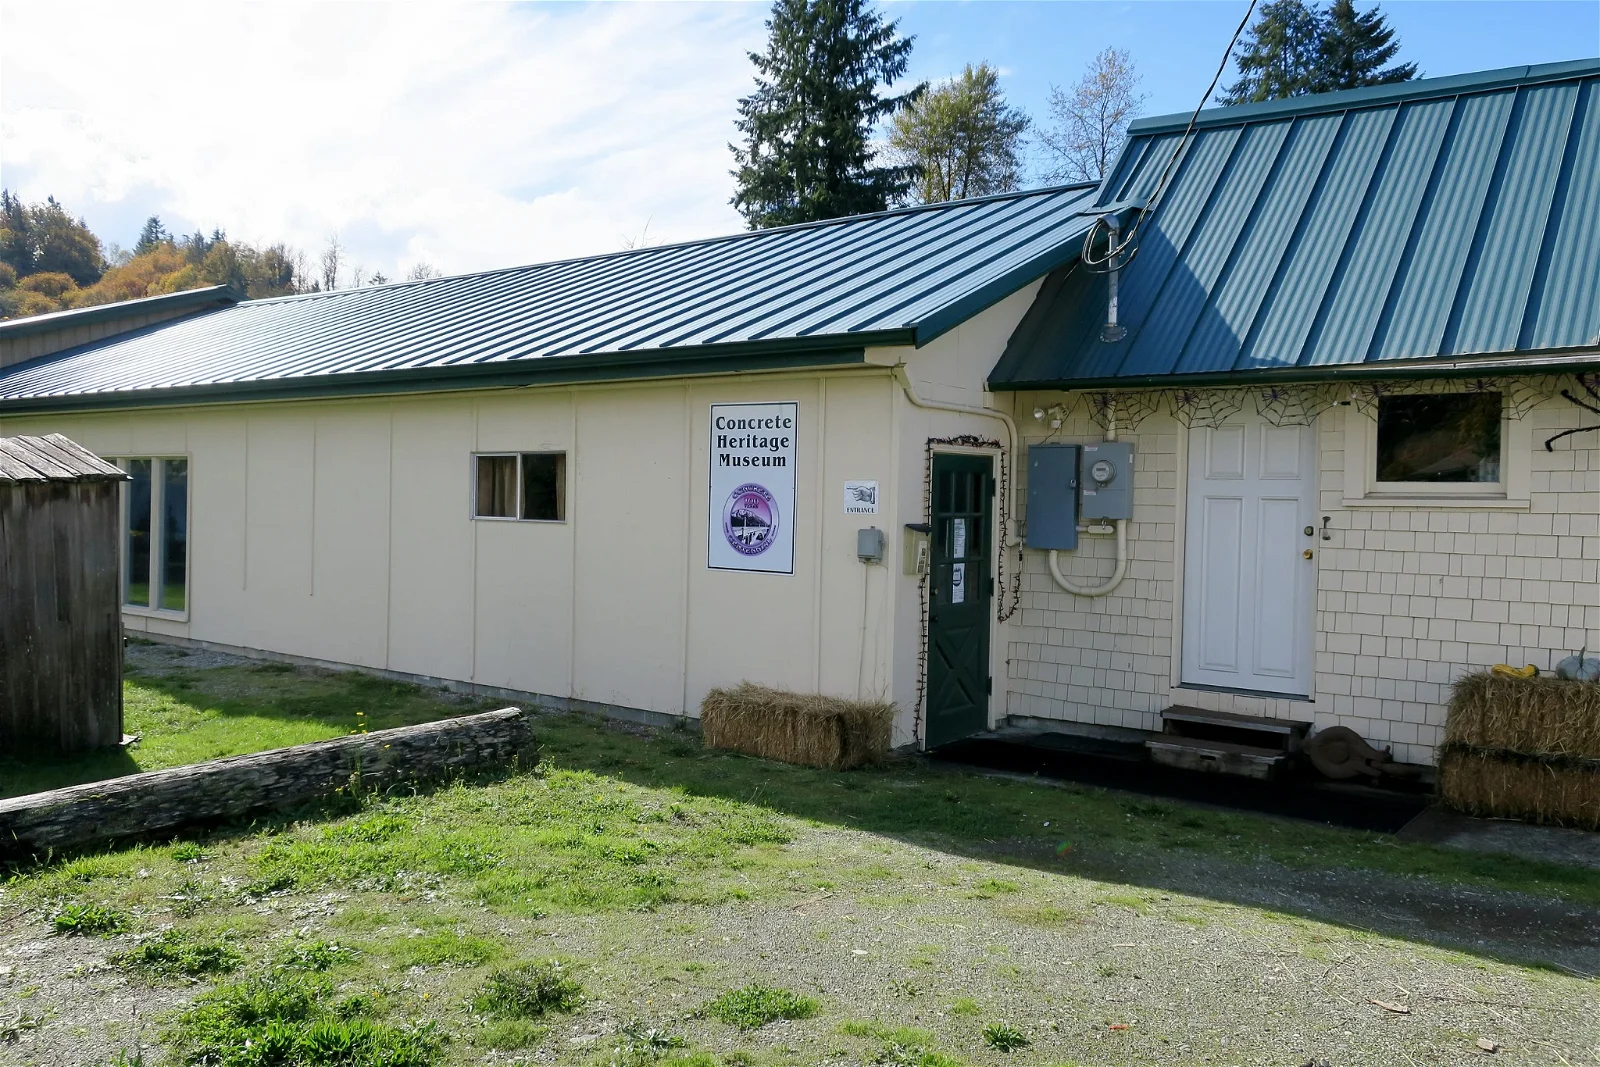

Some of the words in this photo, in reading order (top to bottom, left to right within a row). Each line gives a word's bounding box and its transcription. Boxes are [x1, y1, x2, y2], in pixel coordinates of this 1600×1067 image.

[715, 416, 791, 429] Concrete
[717, 434, 789, 451] Heritage
[719, 453, 786, 467] Museum
